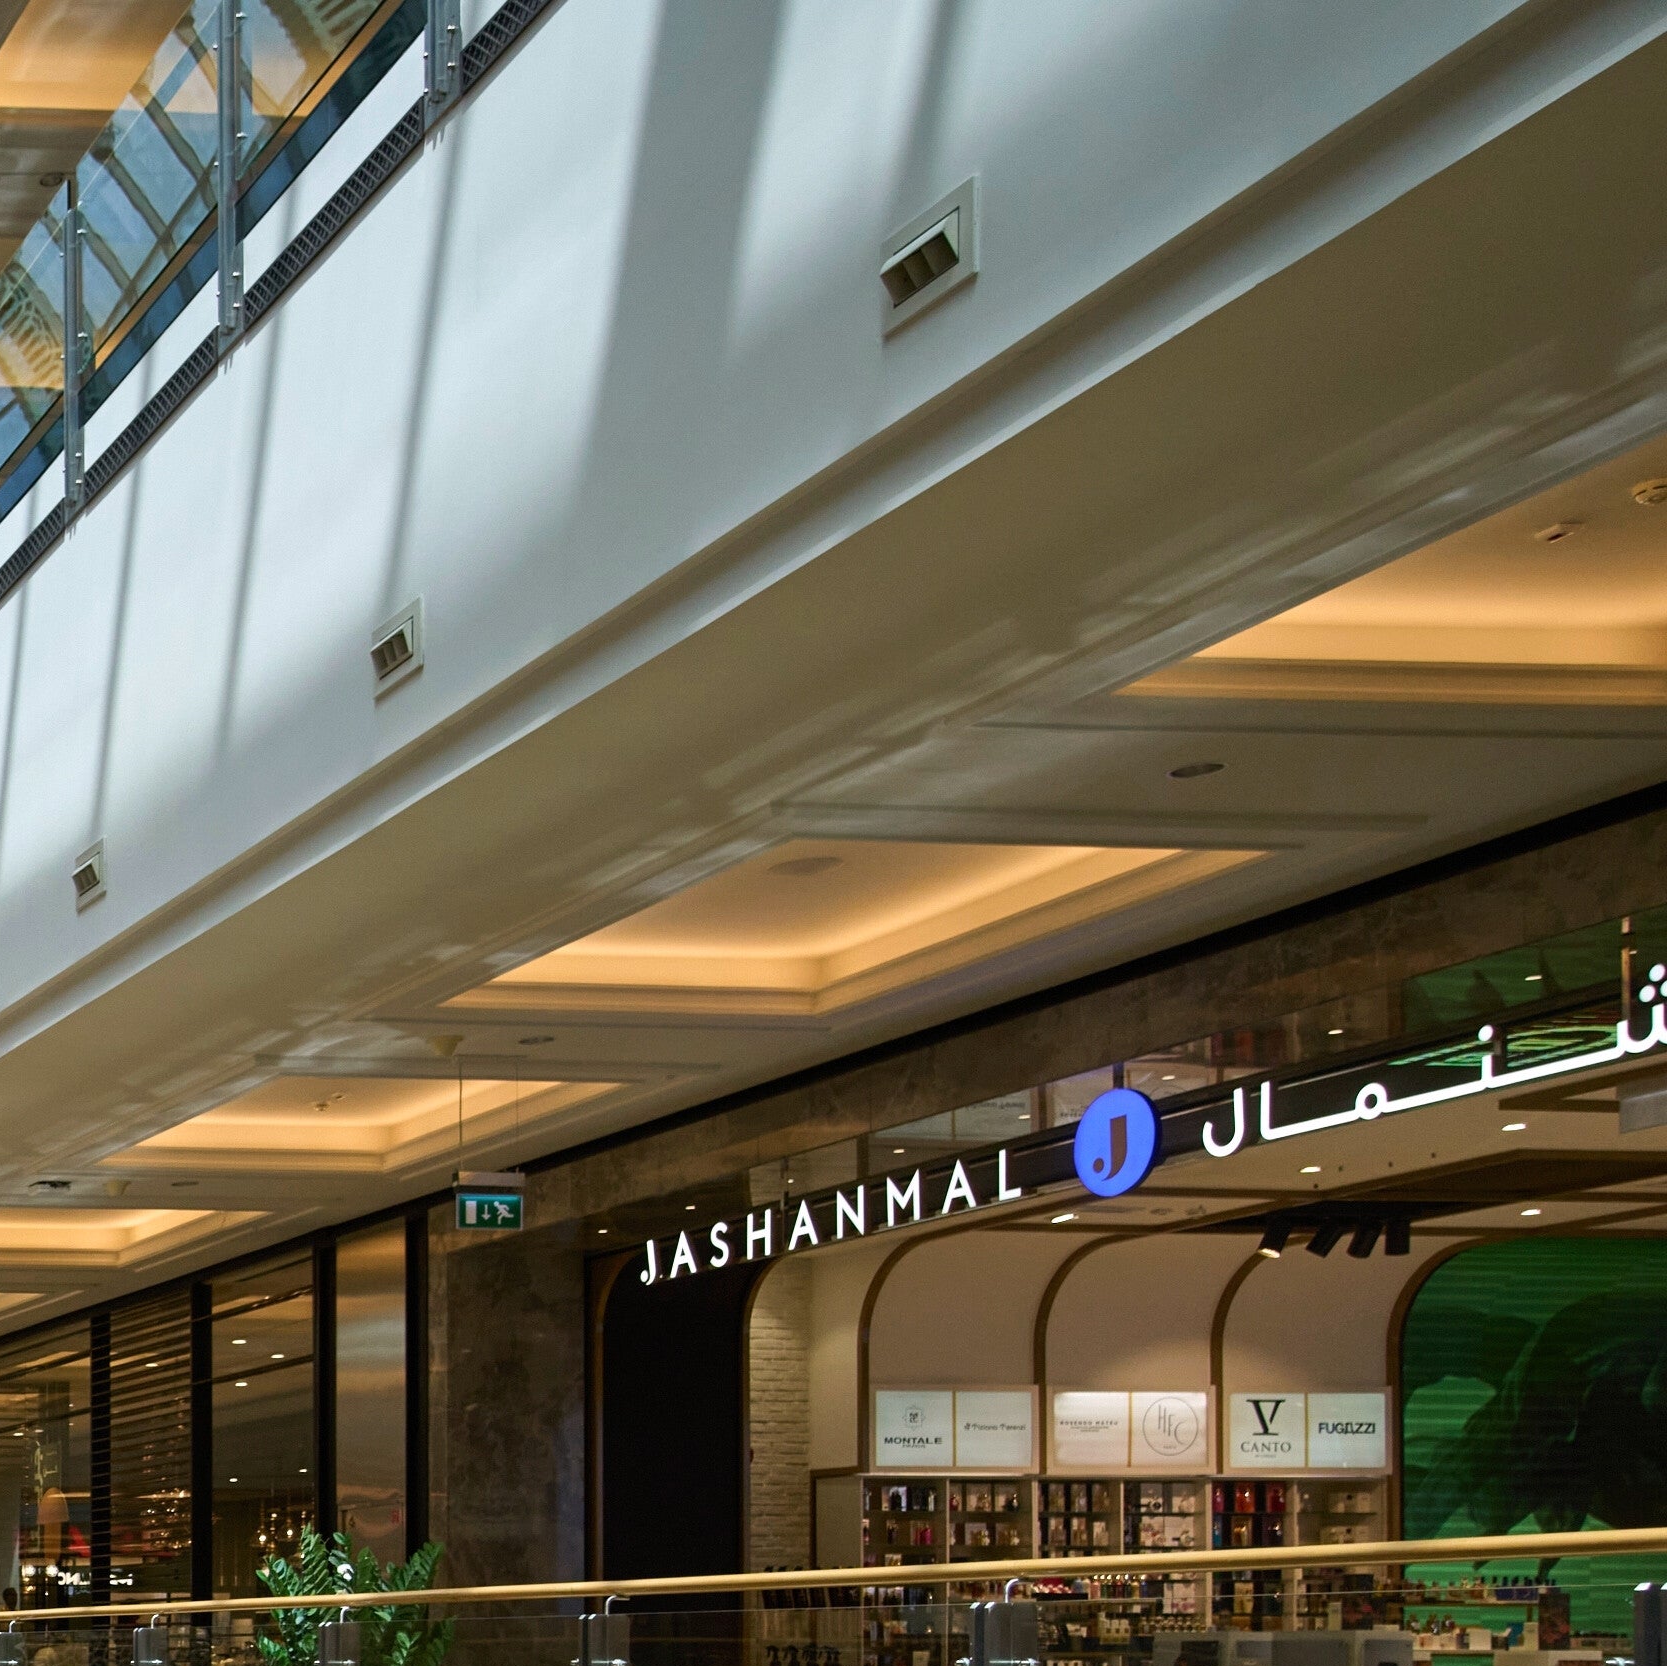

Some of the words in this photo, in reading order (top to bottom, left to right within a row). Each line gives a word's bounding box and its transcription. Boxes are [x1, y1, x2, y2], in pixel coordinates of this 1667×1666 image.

[640, 1149, 1021, 1286] JASHANMAL
[884, 1436, 943, 1445] MONTALE
[1240, 1441, 1292, 1453] CANTO
